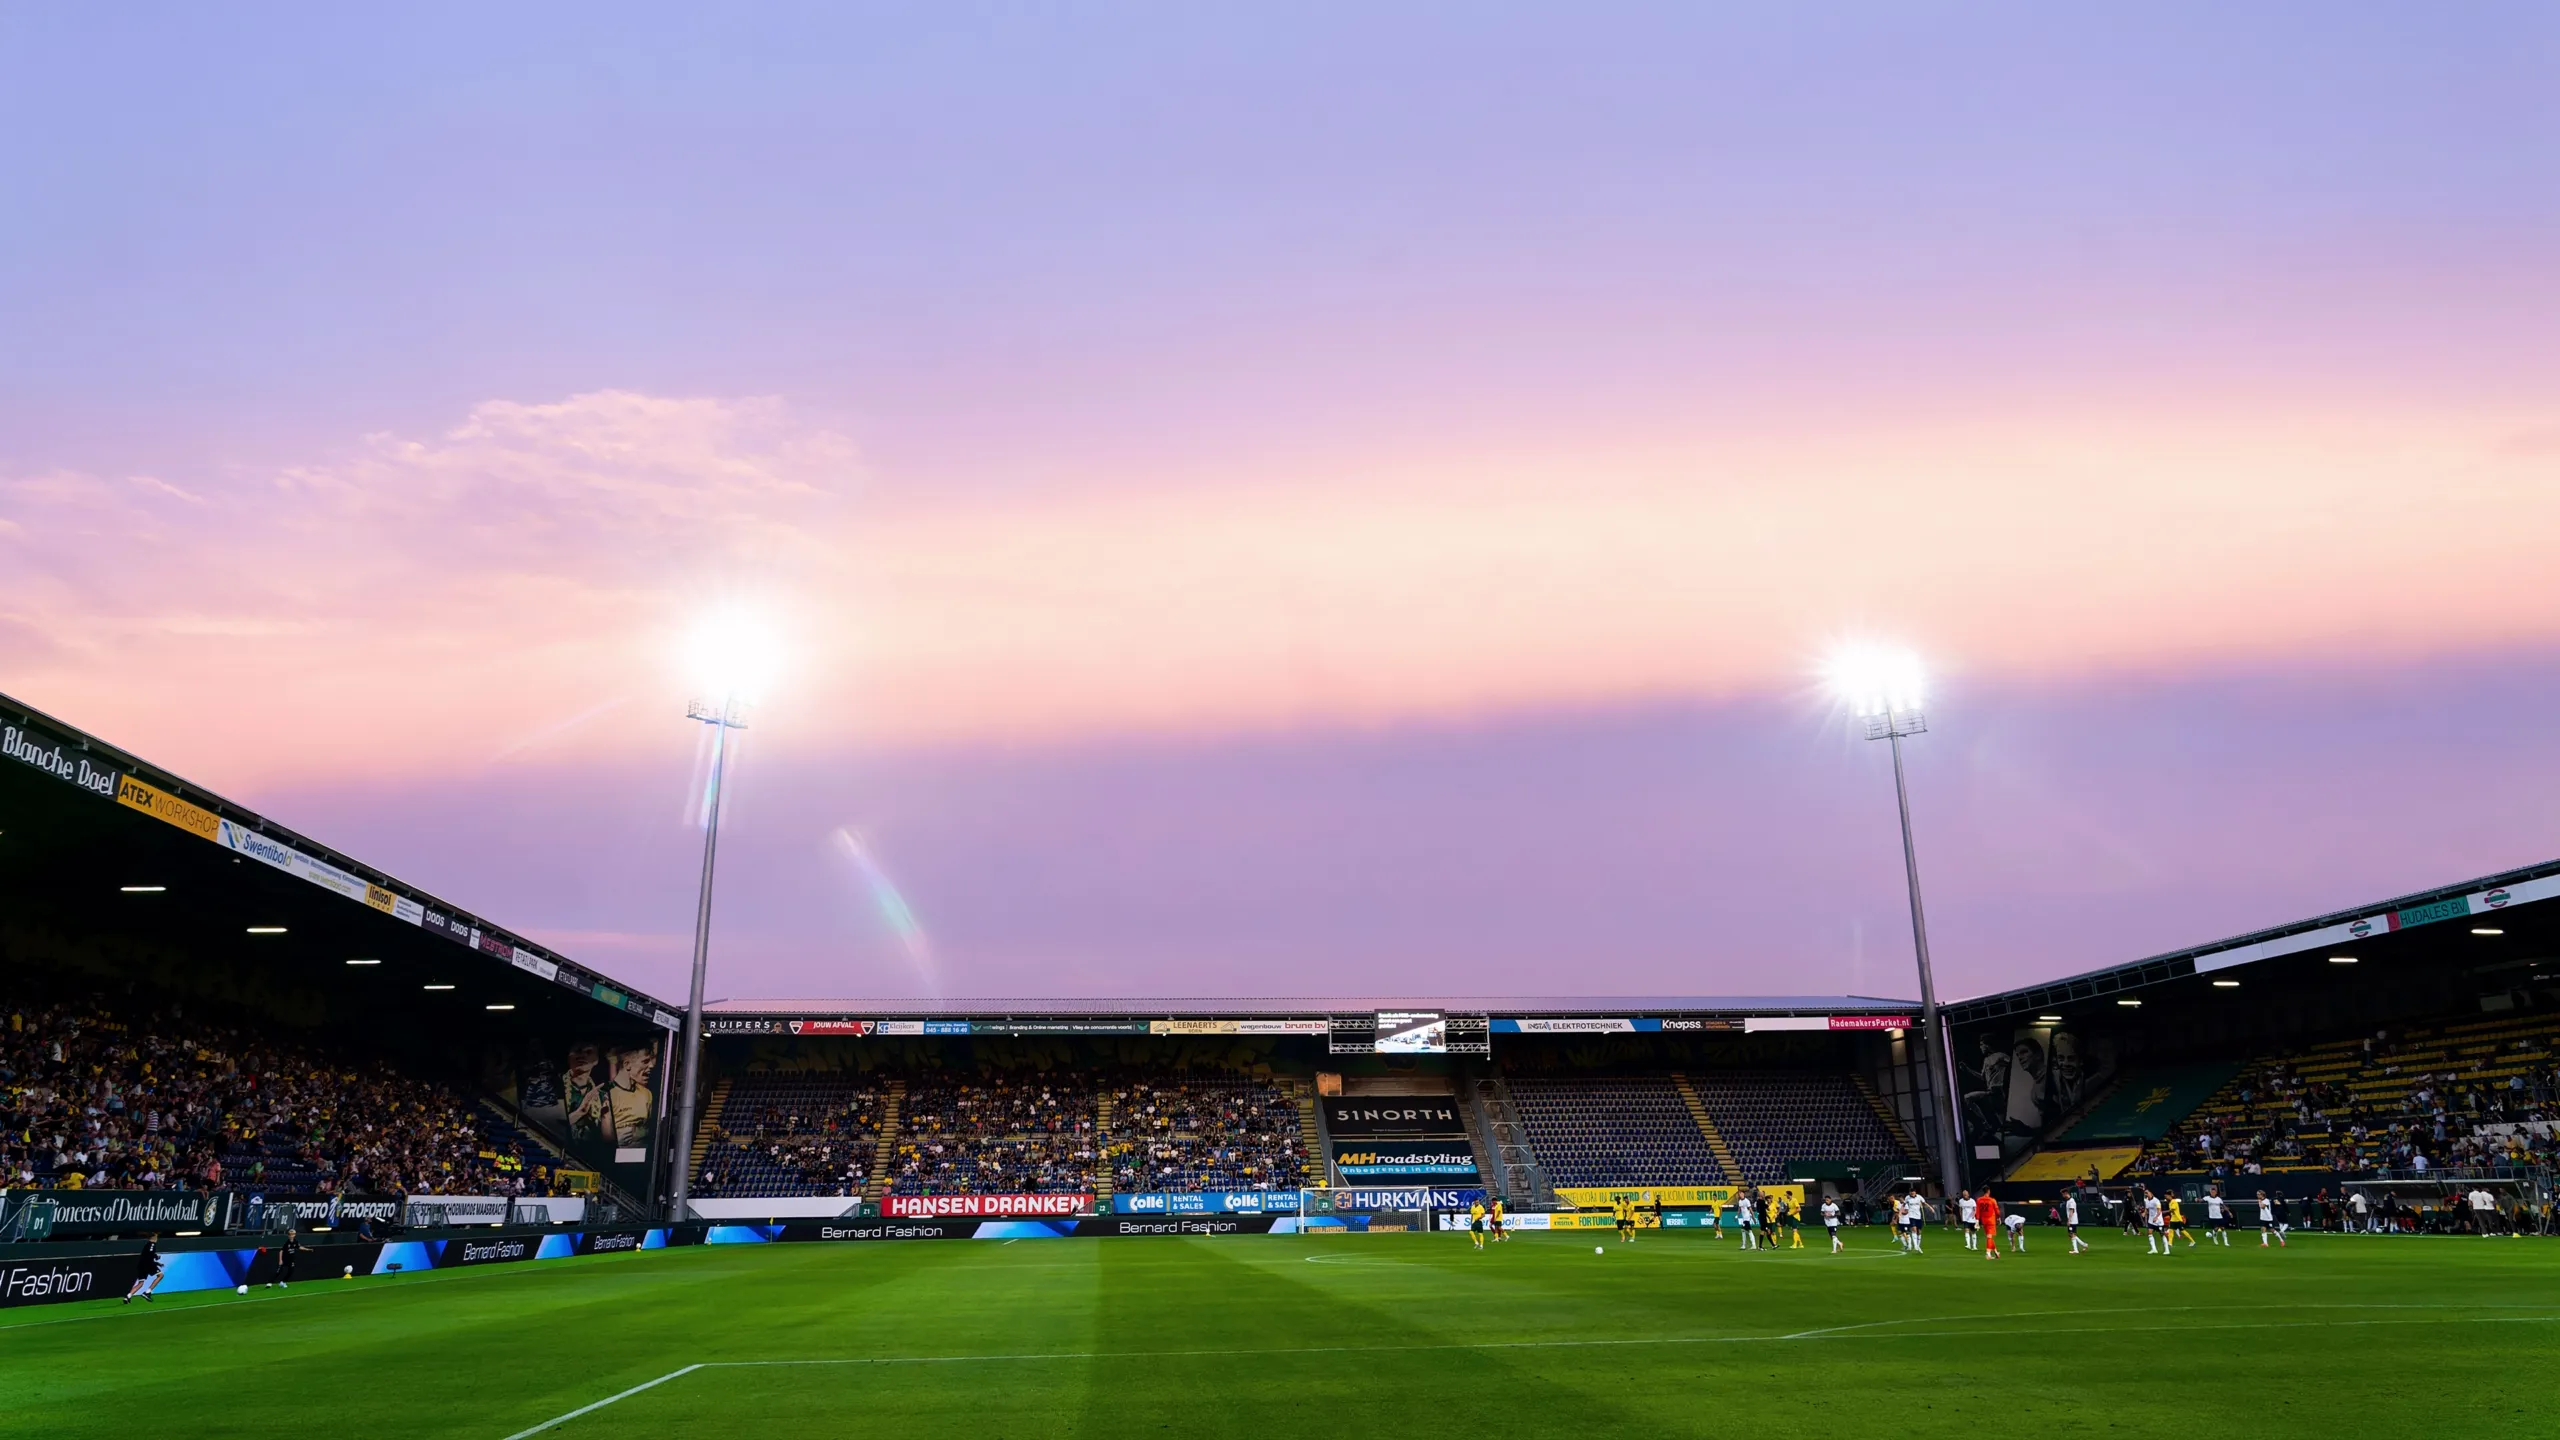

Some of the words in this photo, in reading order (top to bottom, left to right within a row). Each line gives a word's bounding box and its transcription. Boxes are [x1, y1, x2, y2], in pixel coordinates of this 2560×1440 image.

[3, 726, 74, 780] Blanche
[77, 759, 116, 796] Dael
[120, 782, 154, 808] ATEX
[155, 795, 219, 833] WORKSHOP
[243, 833, 293, 867] Swentibold
[2401, 904, 2449, 925] HUDALES
[813, 1021, 832, 1029] JOUW
[1552, 1022, 1623, 1030] ELEKTROTECHNIEK
[1830, 1018, 1910, 1028] RademakersParket.nl
[1342, 1166, 1407, 1174] Onbegrensd
[1130, 1195, 1164, 1211] Collé
[1225, 1194, 1259, 1210] Collé
[1355, 1191, 1459, 1208] HURKMANS
[1687, 1190, 1694, 1200] IN
[102, 1199, 117, 1221] of
[116, 1198, 156, 1221] Dutch
[154, 1197, 199, 1221] football.
[341, 1202, 396, 1217] PROFORTO
[893, 1197, 978, 1214] HANSEN
[985, 1196, 1084, 1214] DRANKEN
[821, 1227, 882, 1239] Bernard
[886, 1225, 943, 1237] Fashion
[1119, 1222, 1177, 1234] Bernard
[1181, 1221, 1236, 1232] Fashion
[463, 1246, 495, 1261] Bernard
[496, 1242, 524, 1258] Fashion
[7, 1266, 92, 1298] Fashion
